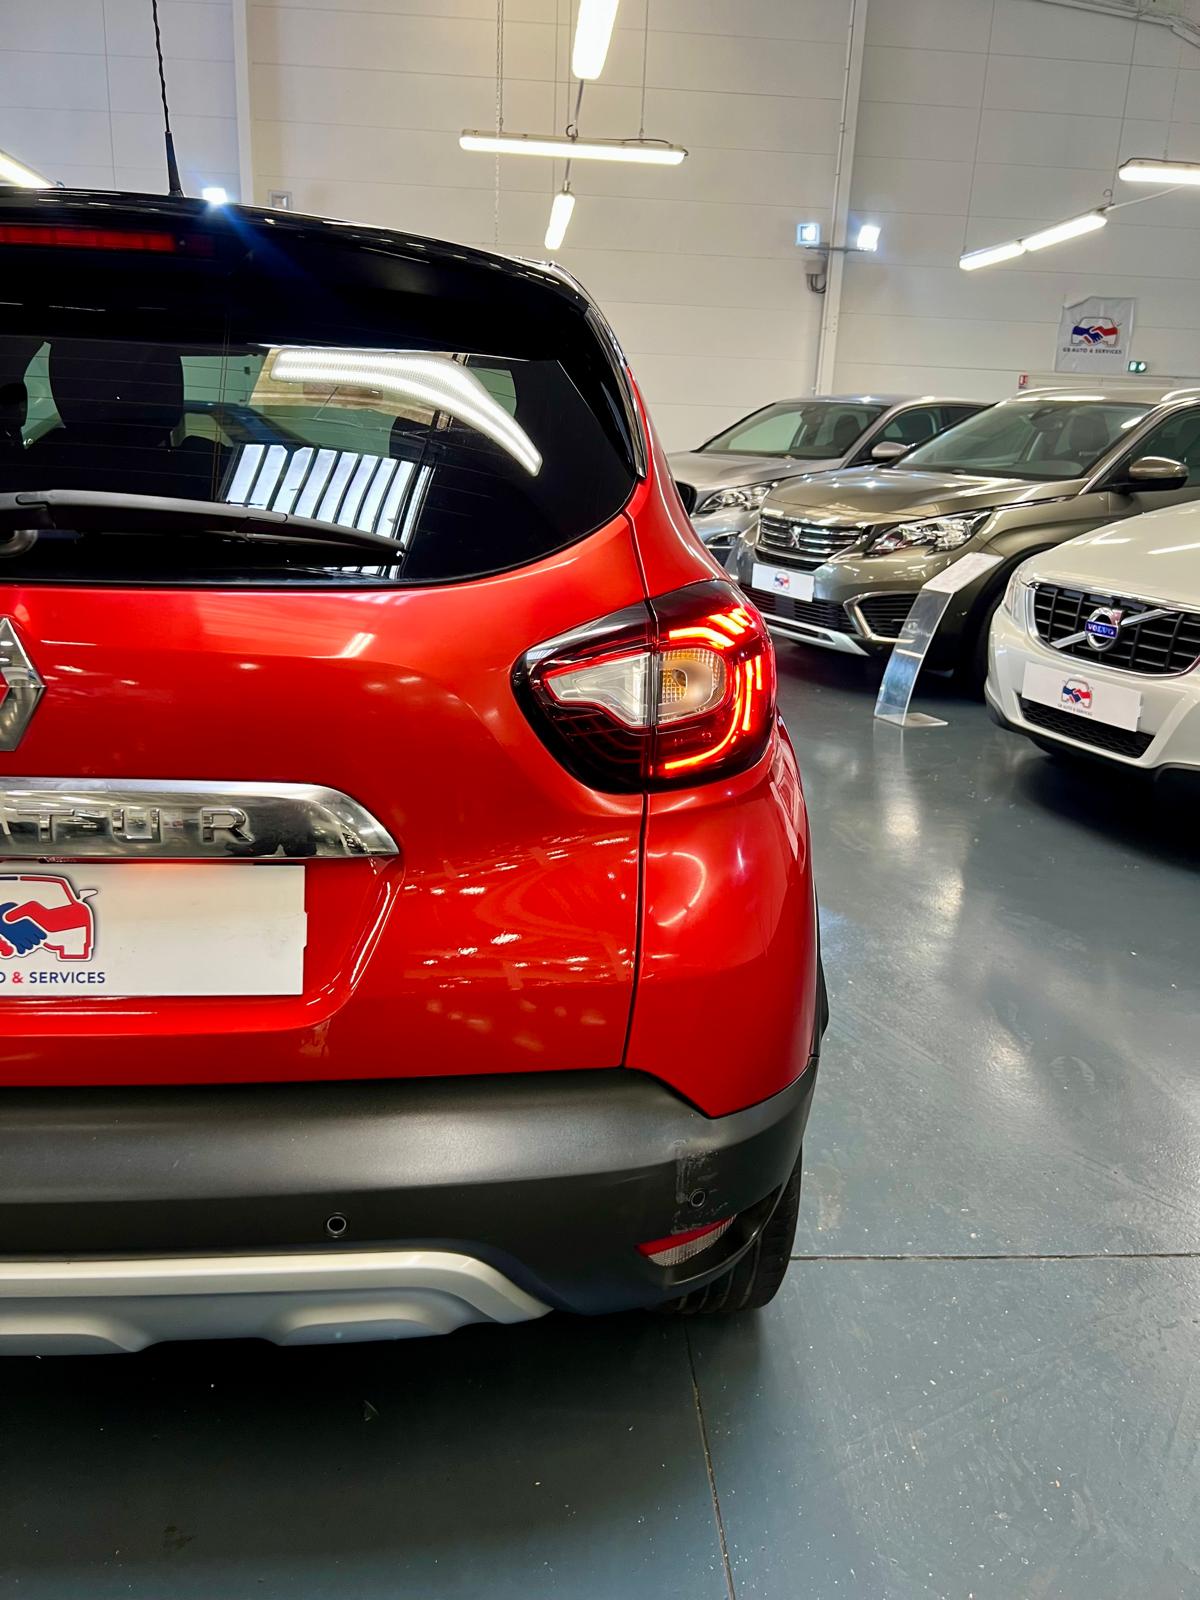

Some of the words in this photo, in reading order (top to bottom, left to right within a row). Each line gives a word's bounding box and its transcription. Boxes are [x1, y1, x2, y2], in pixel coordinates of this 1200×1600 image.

[1087, 623, 1115, 635] VOLVO
[11, 971, 23, 984] &
[29, 971, 105, 984] SERVICES
